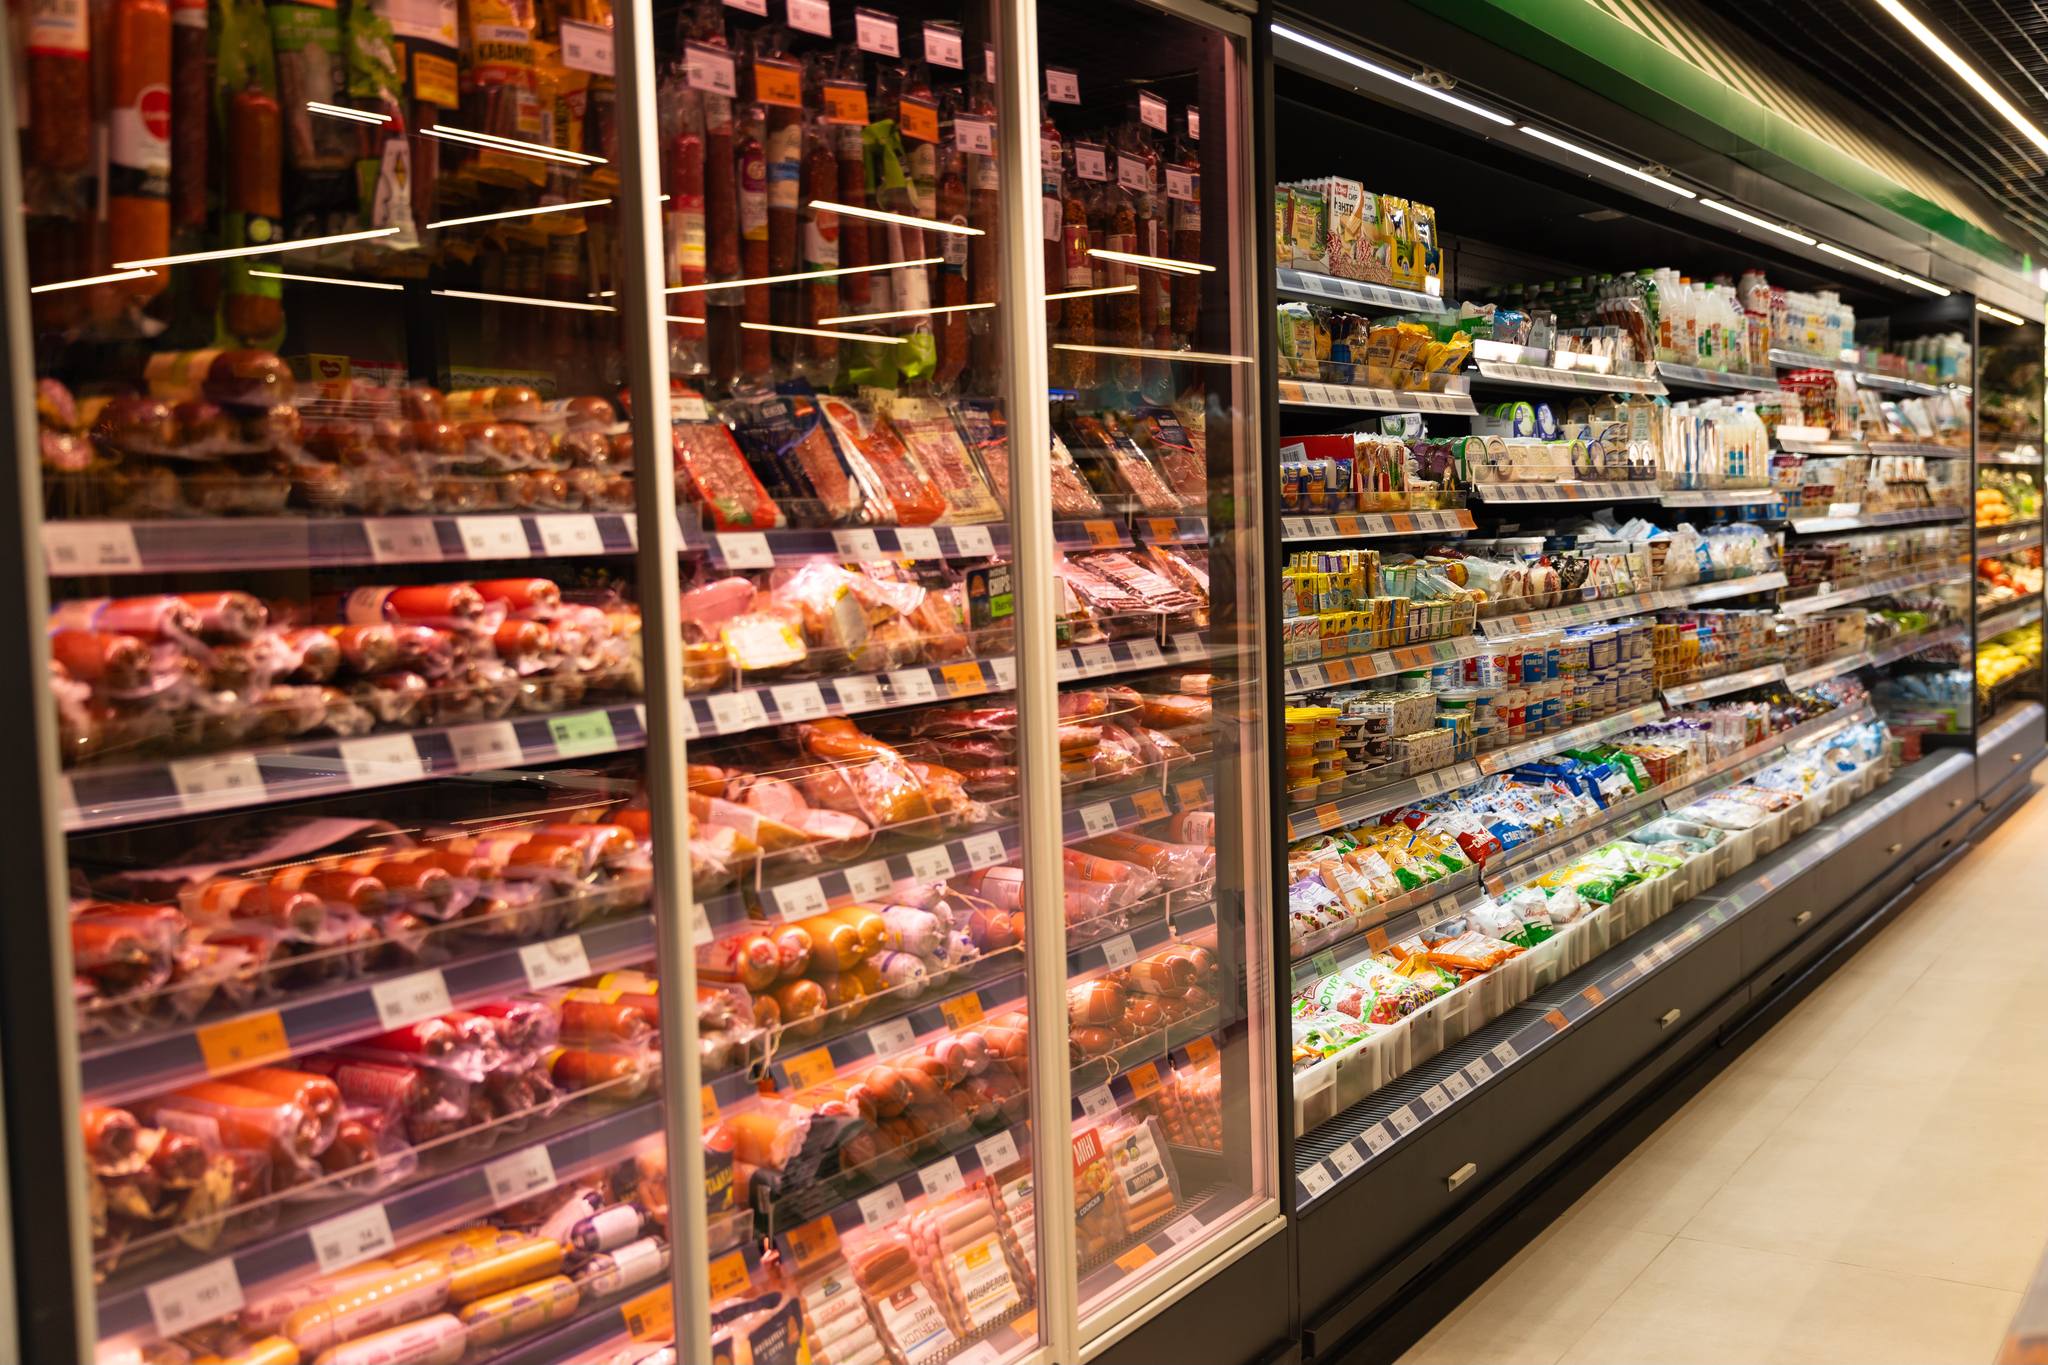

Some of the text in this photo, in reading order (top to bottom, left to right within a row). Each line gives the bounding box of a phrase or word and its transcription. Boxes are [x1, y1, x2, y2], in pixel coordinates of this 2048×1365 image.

[1073, 1133, 1097, 1167] МІНІ
[1079, 1195, 1101, 1217] СОСИСКИ
[966, 1272, 1009, 1301] МОЦАРЕЛОЮ
[915, 1305, 936, 1321] ПРИ
